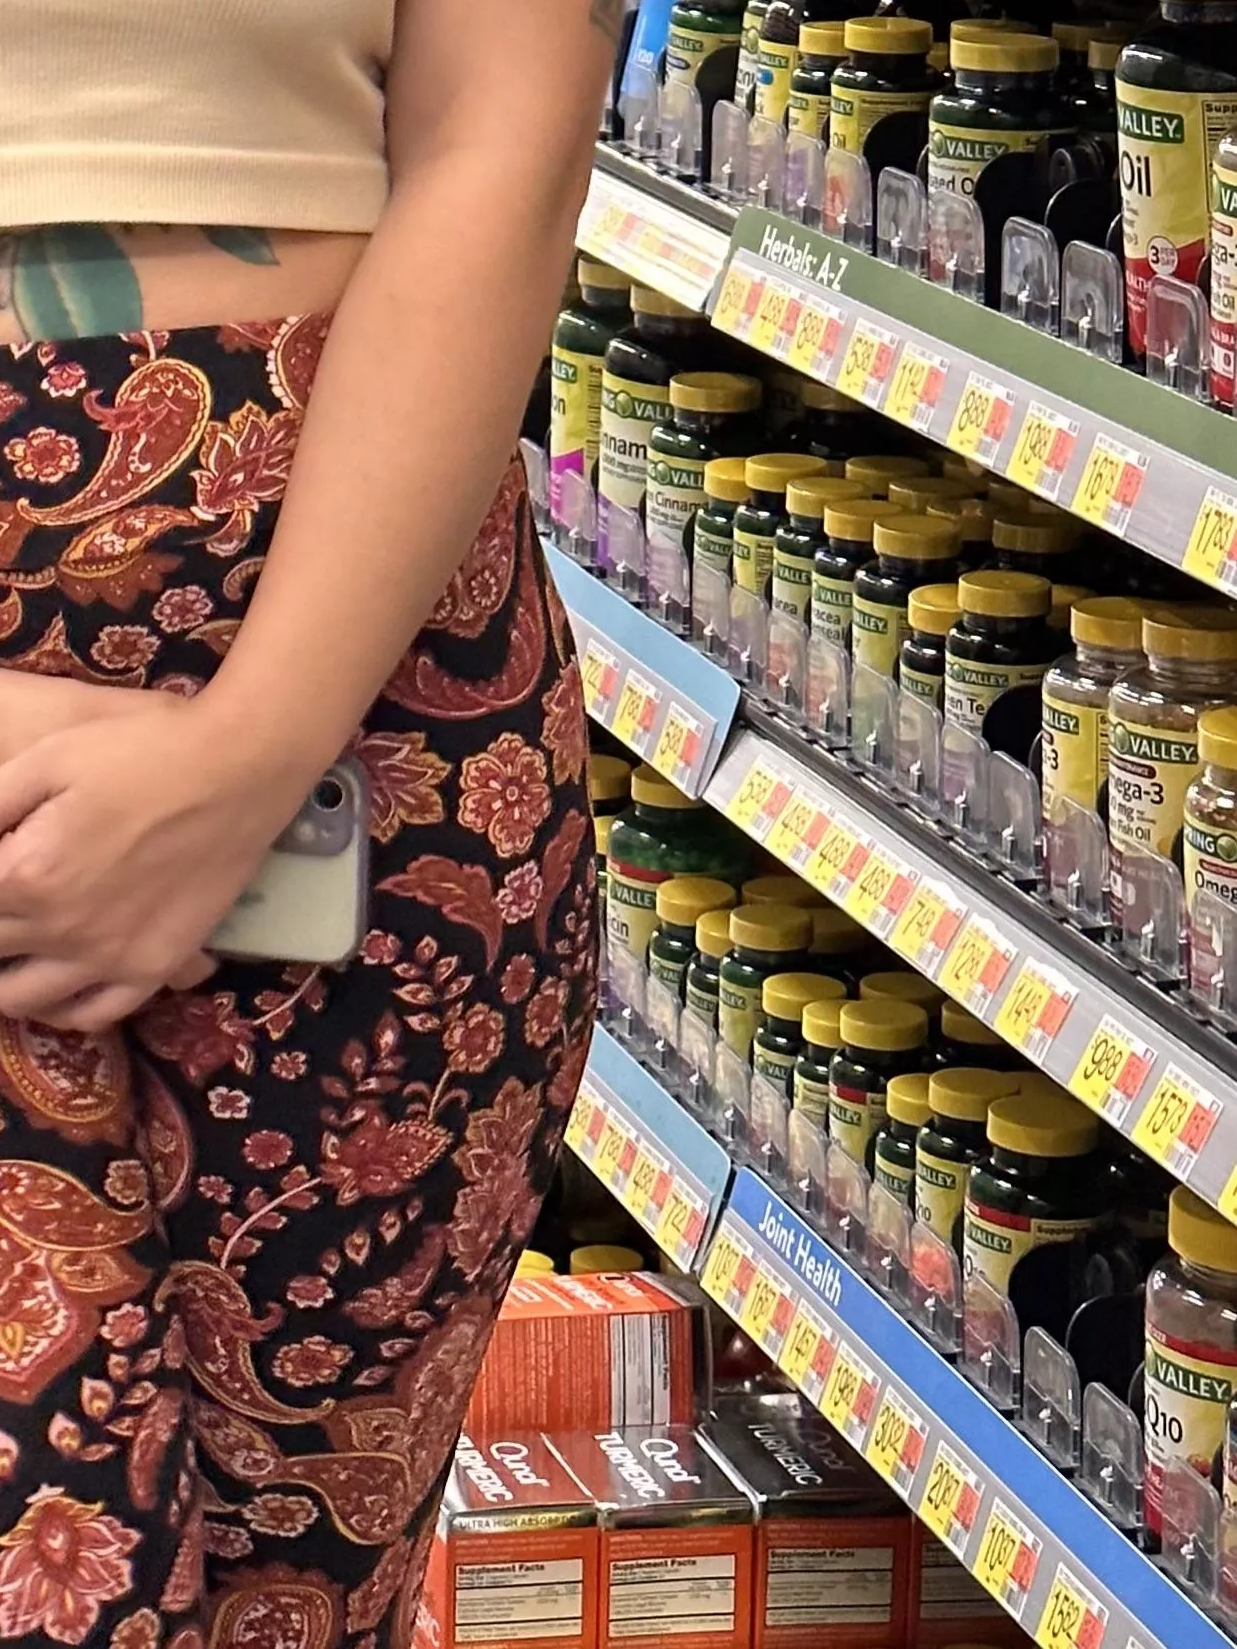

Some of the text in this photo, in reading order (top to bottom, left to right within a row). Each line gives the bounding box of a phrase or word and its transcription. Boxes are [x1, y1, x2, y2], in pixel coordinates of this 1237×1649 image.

[1117, 108, 1182, 140] VALLEY
[944, 140, 1010, 162] VALLEY
[1119, 155, 1153, 198] Oil
[759, 224, 850, 291] Herbals: A-Z
[635, 402, 672, 421] VALL
[670, 470, 703, 488] VALL
[654, 490, 704, 511] Cinnam
[777, 566, 808, 584] VALLE
[820, 590, 852, 608] VALLE
[962, 668, 1008, 688] VALLEY
[1129, 736, 1197, 763] VALLEY
[1134, 825, 1152, 842] Oil
[616, 884, 656, 907] VALLE
[1194, 869, 1237, 900] Omeg
[758, 1201, 843, 1307] Joint Health
[1156, 1360, 1230, 1401] VALLEY
[1146, 1393, 1184, 1444] Q10
[593, 1432, 667, 1500] TURMERIC
[747, 1422, 825, 1489] TURMERIC
[458, 1519, 492, 1531] ULTRA
[493, 1517, 518, 1529] HIGH
[611, 1557, 697, 1572] Supplement Facts
[770, 1549, 856, 1560] Supplement Facts
[457, 1562, 545, 1576] Supplement Facts
